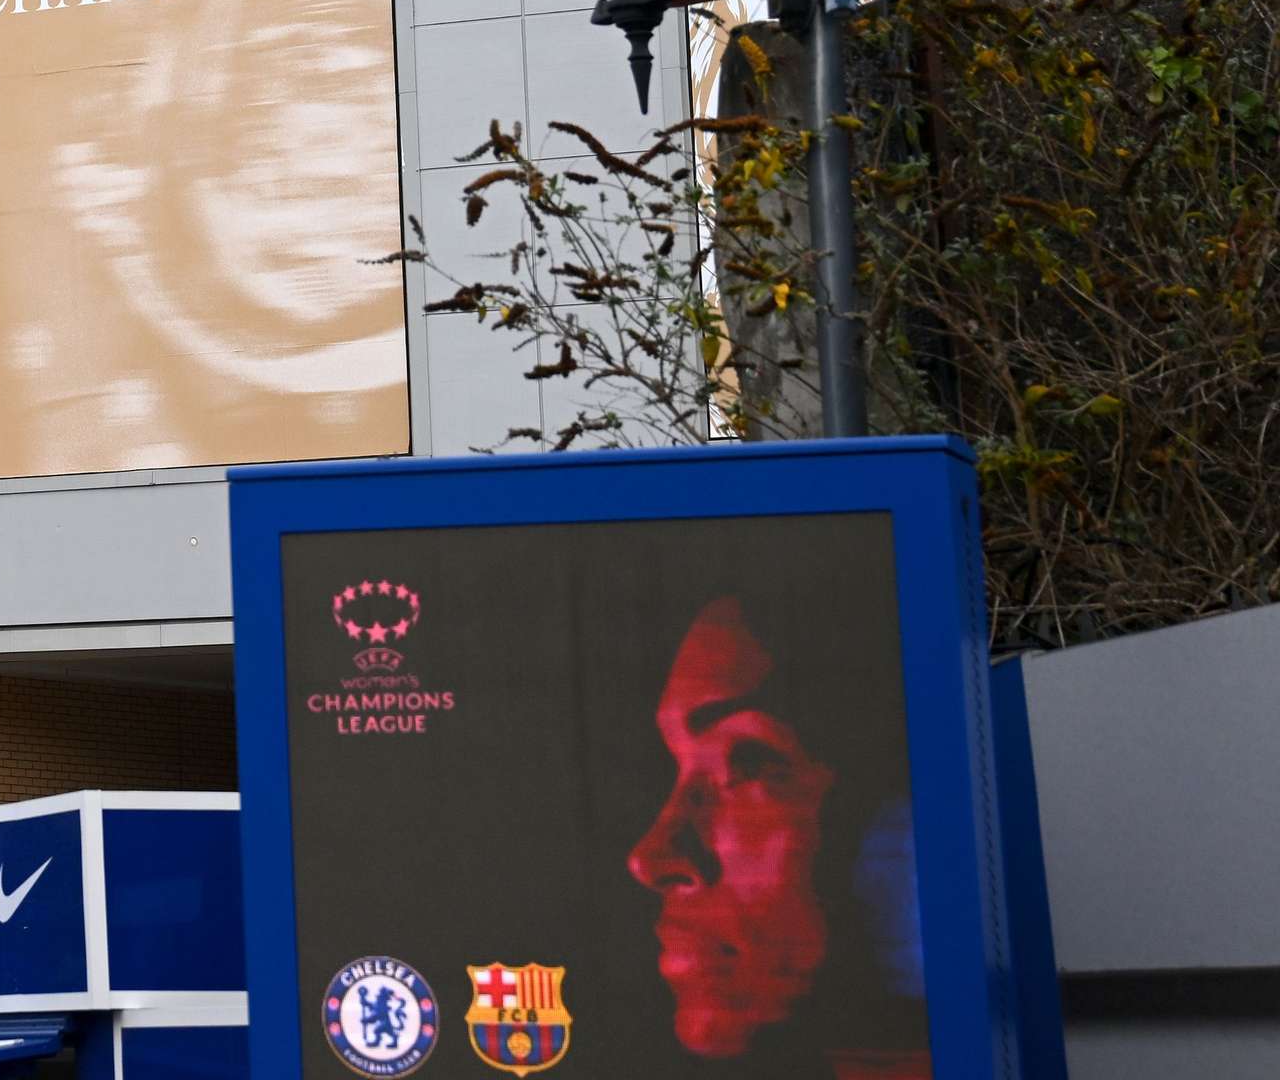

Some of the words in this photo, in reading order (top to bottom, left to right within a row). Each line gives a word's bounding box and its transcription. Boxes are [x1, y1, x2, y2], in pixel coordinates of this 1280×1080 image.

[355, 650, 400, 669] UEFA
[307, 692, 455, 712] CHAMPIONS
[337, 715, 427, 734] LEAGUE
[341, 960, 415, 987] CHELSEA
